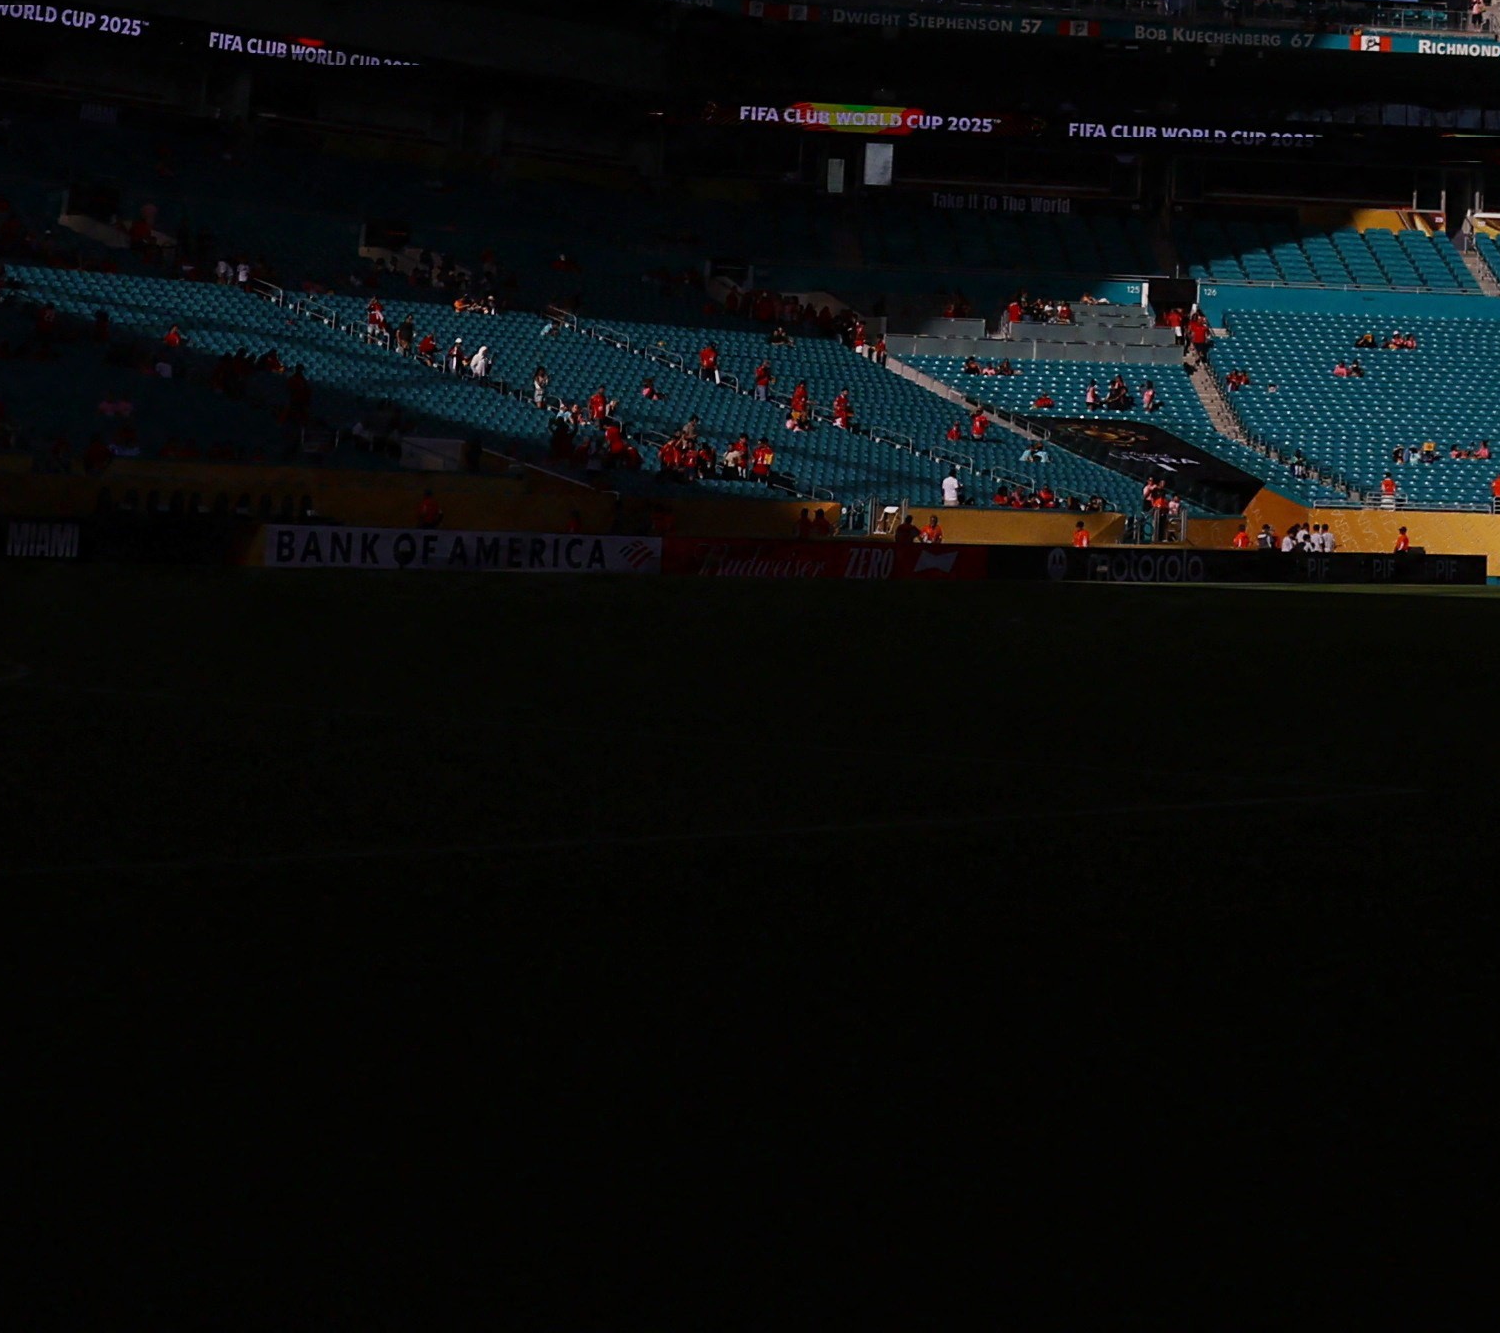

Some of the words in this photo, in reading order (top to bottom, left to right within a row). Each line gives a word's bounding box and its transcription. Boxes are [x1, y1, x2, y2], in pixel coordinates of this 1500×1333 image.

[60, 9, 96, 30] CUP
[833, 8, 902, 27] DWIGHT
[906, 11, 1013, 33] STEPHENSON
[1019, 17, 1043, 34] 57
[208, 31, 243, 54] FIFA
[246, 37, 288, 59] CLUB
[290, 45, 346, 67] WORLD
[1134, 24, 1167, 41] BOB
[1171, 26, 1281, 48] KUECHENBERG
[1290, 33, 1315, 49] 67
[739, 105, 780, 122] FIFA
[783, 107, 830, 124] CLUB
[835, 110, 903, 129] WORLD
[906, 114, 943, 130] CUP
[1068, 122, 1108, 139] FIFA
[1161, 126, 1228, 145] WORLD
[1230, 130, 1267, 147] CUP
[931, 191, 964, 208] Take
[982, 193, 998, 210] To
[1001, 194, 1027, 212] The
[1030, 196, 1071, 215] World
[1126, 285, 1140, 295] 125
[1203, 287, 1217, 297] 126
[6, 521, 80, 561] MIAMI
[276, 532, 380, 564] BANK
[393, 533, 437, 565] OF
[448, 535, 607, 570] AMERICA
[698, 542, 827, 578] Budweiser
[843, 546, 895, 580] ZERO
[1086, 552, 1204, 581] motorola
[1307, 558, 1331, 579] PIF
[1372, 558, 1396, 579] PIF
[1434, 559, 1458, 580] PIF
